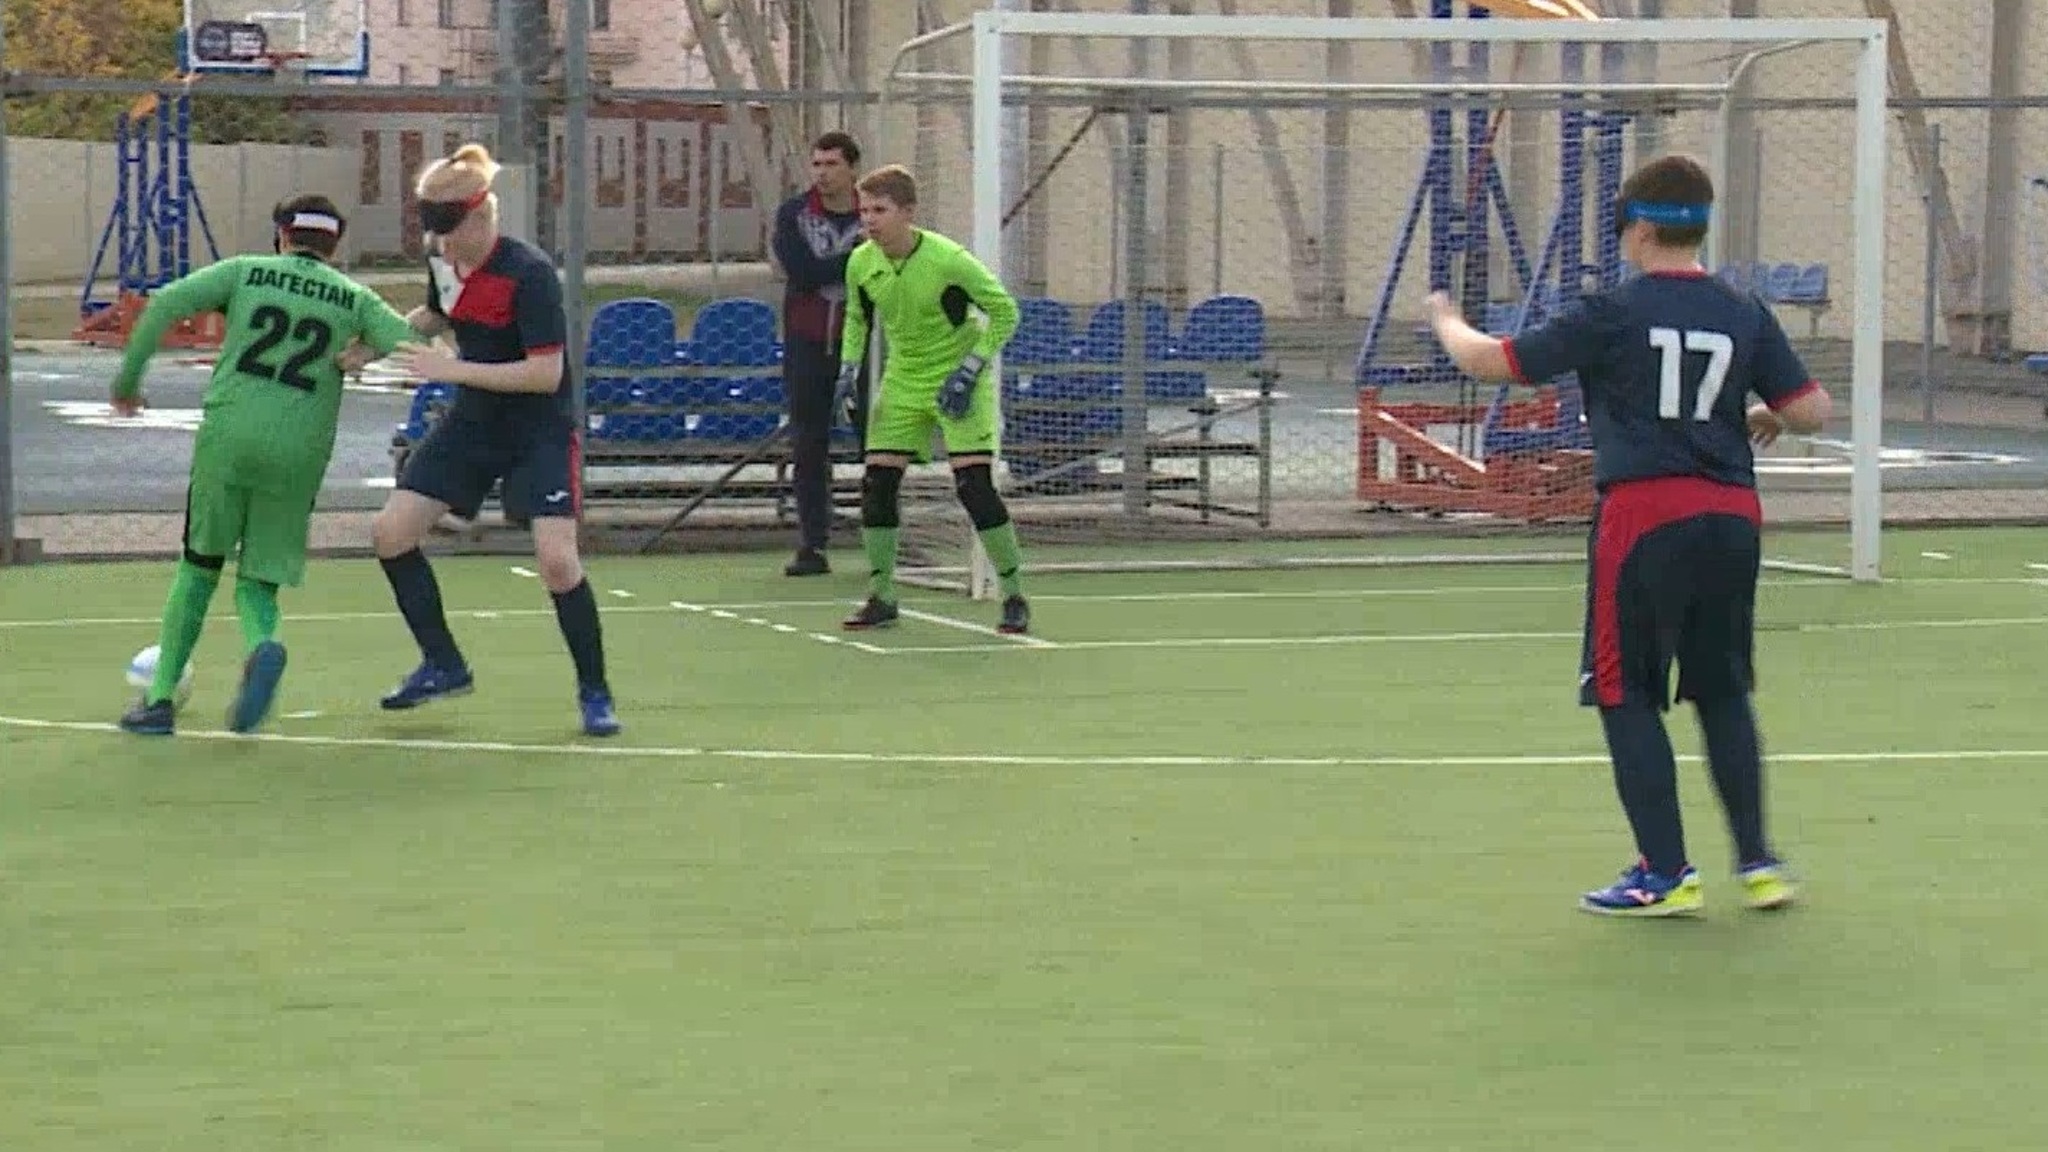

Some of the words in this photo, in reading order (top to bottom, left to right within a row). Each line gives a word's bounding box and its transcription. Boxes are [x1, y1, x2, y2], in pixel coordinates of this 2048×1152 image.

[246, 266, 355, 310] ДАГЕСТАН
[236, 305, 332, 392] 22
[1649, 327, 1734, 422] 17
